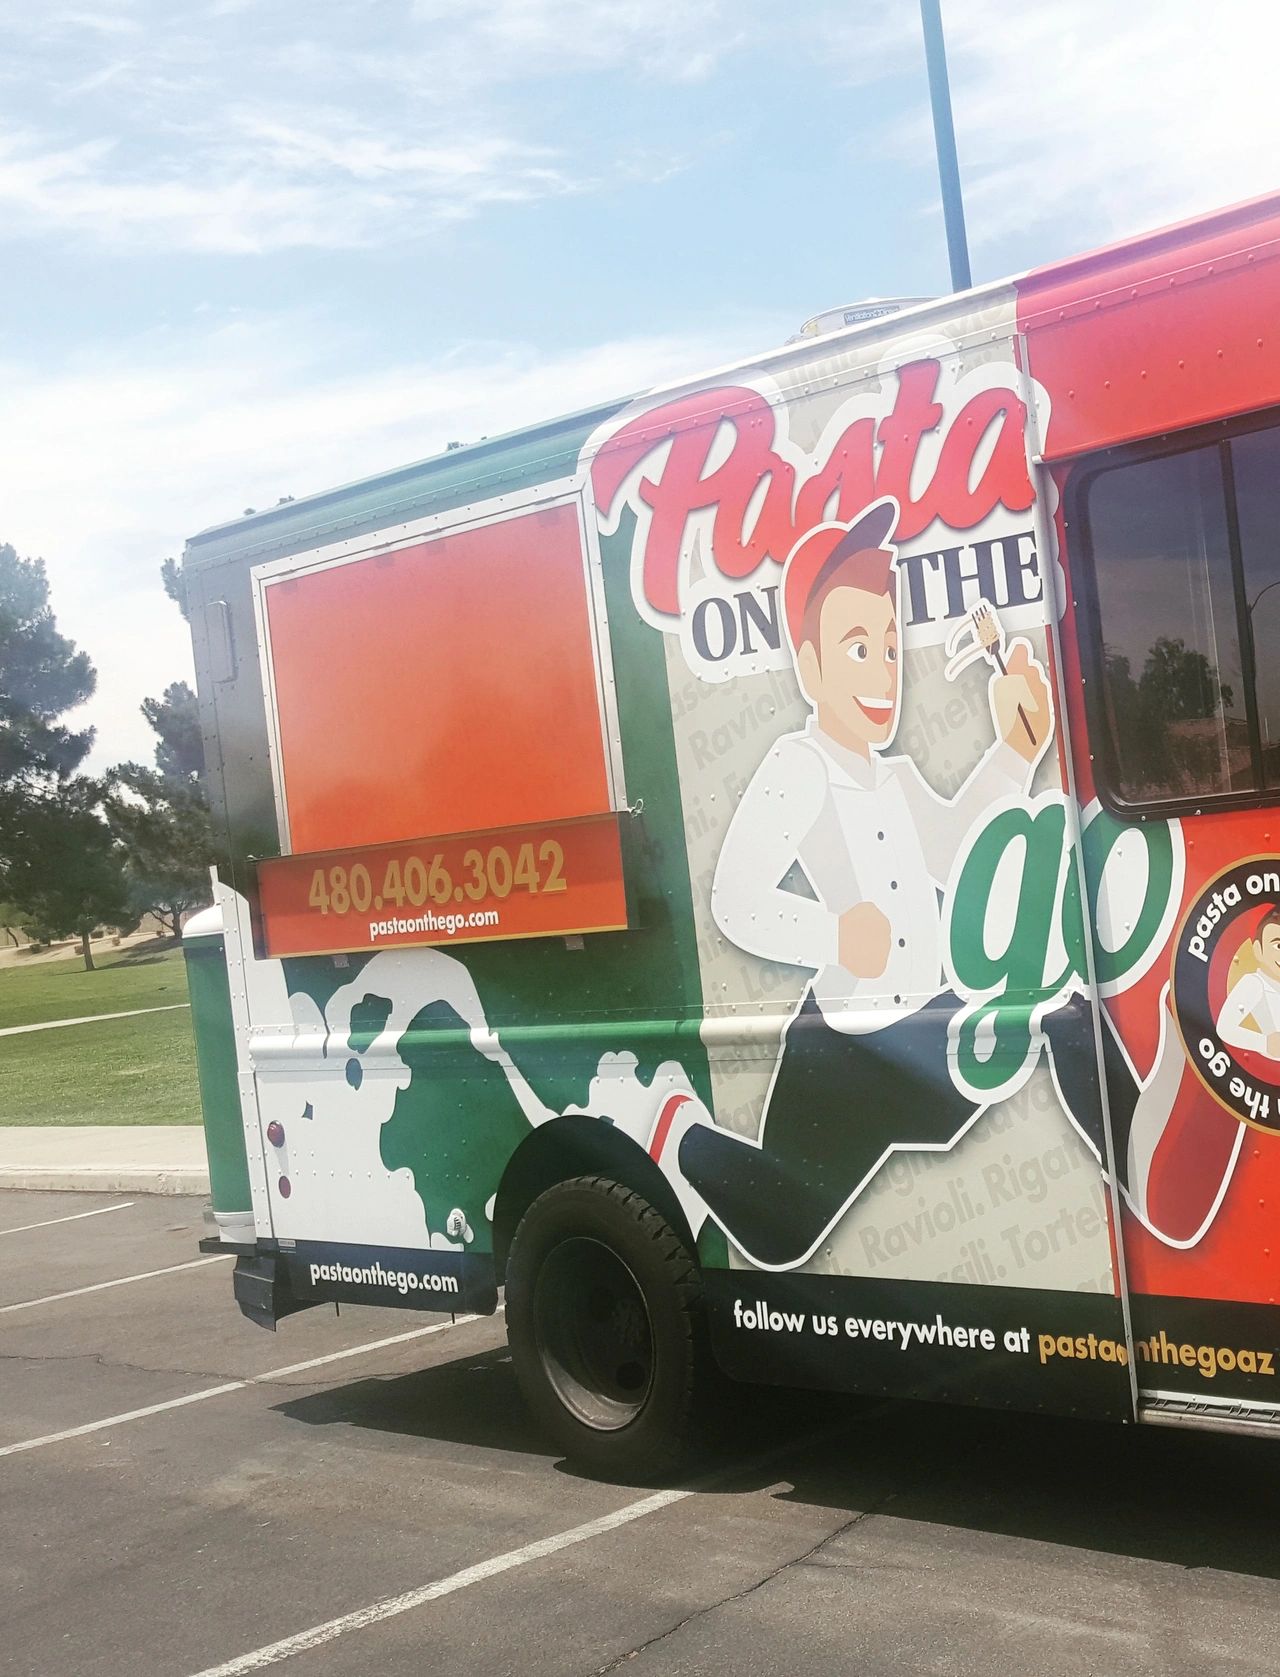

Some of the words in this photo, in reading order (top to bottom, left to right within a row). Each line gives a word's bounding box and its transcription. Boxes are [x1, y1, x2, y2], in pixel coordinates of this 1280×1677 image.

[592, 358, 1037, 616] Pasta
[692, 585, 781, 661] ON
[899, 531, 1043, 627] THE
[309, 840, 568, 915] 480.406.3042
[369, 910, 499, 942] pastaonthego.com
[950, 803, 1170, 1091] go
[1188, 884, 1242, 963] pasta
[1245, 872, 1280, 896] on
[1198, 1038, 1231, 1077] go
[1229, 1077, 1270, 1119] the
[310, 1262, 459, 1294] pastaonthego.com
[733, 1300, 805, 1332] follow
[812, 1314, 838, 1335] us
[845, 1315, 996, 1351] everywhere
[1004, 1328, 1030, 1354] at
